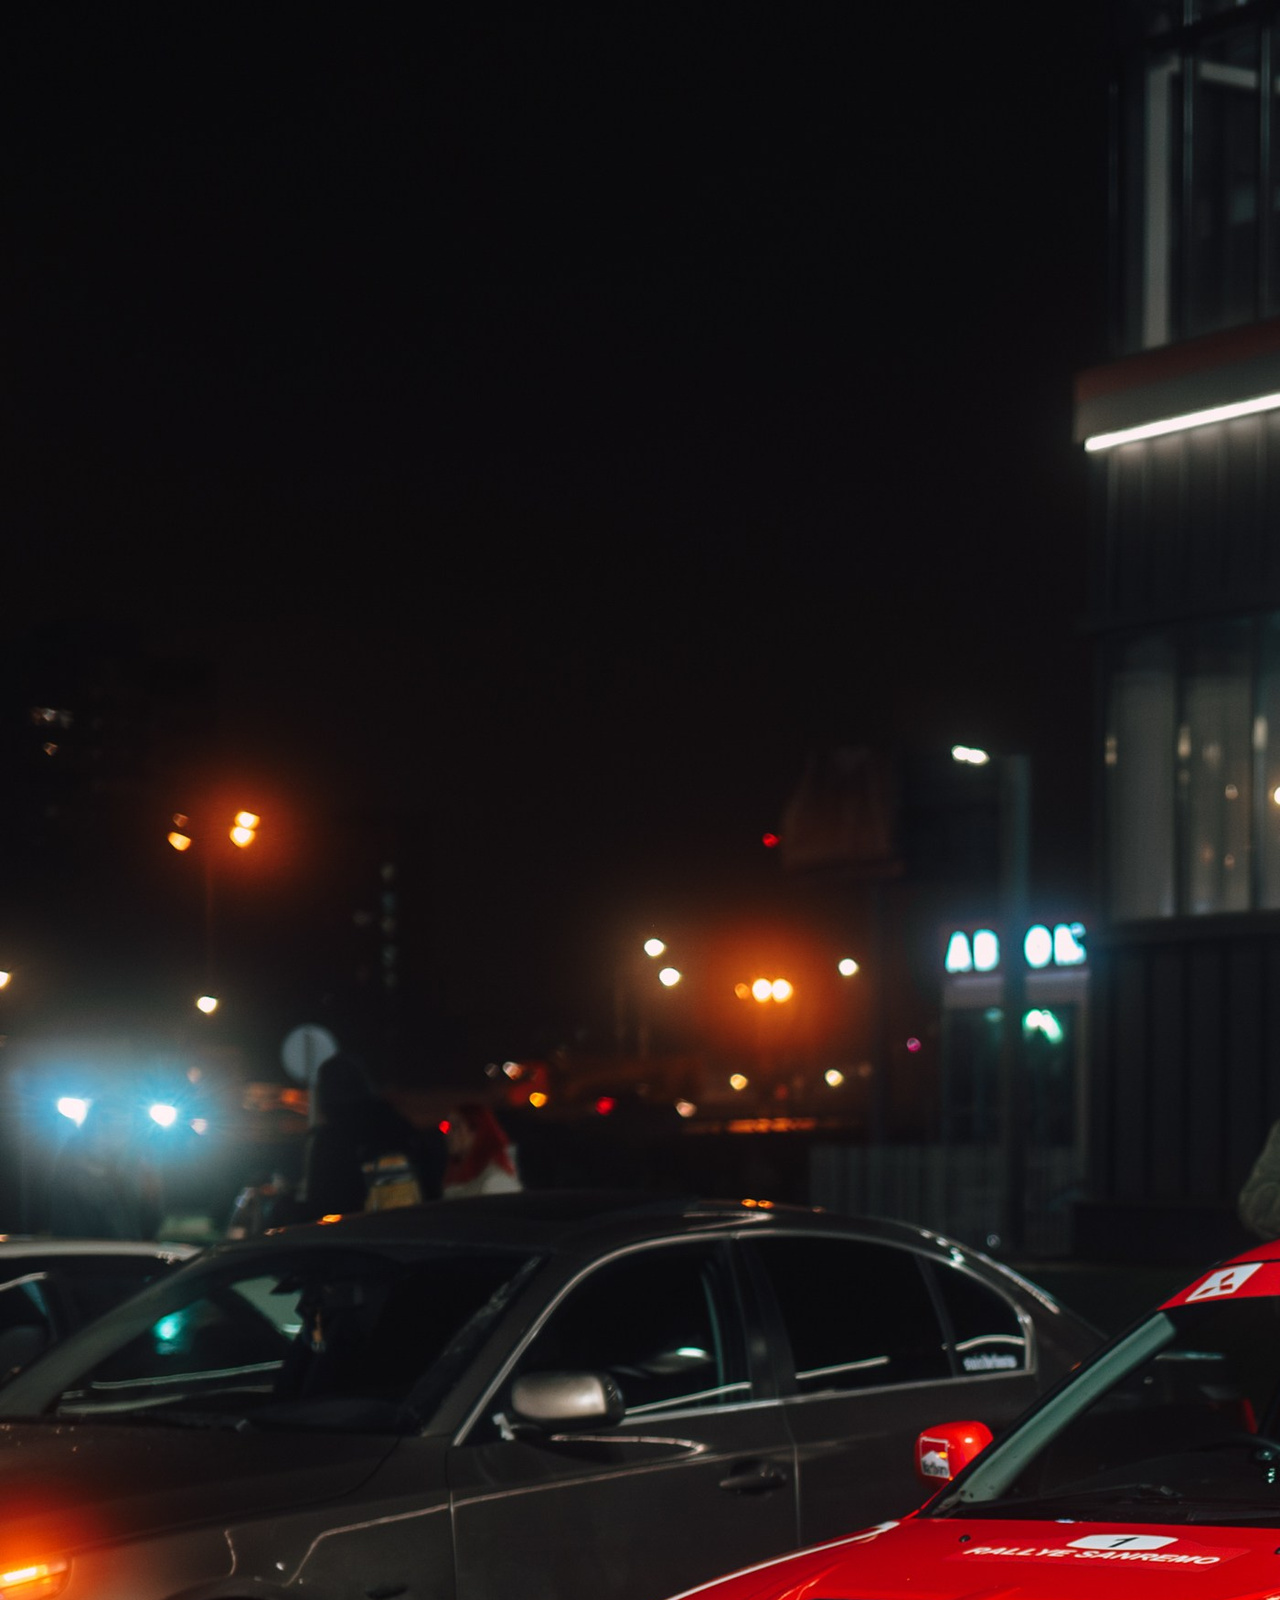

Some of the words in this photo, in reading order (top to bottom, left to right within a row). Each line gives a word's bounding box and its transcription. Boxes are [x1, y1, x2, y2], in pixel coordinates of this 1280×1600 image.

[1108, 1537, 1139, 1548] 1
[963, 1547, 1077, 1557] RALLYE
[1074, 1550, 1221, 1565] SANREMO
